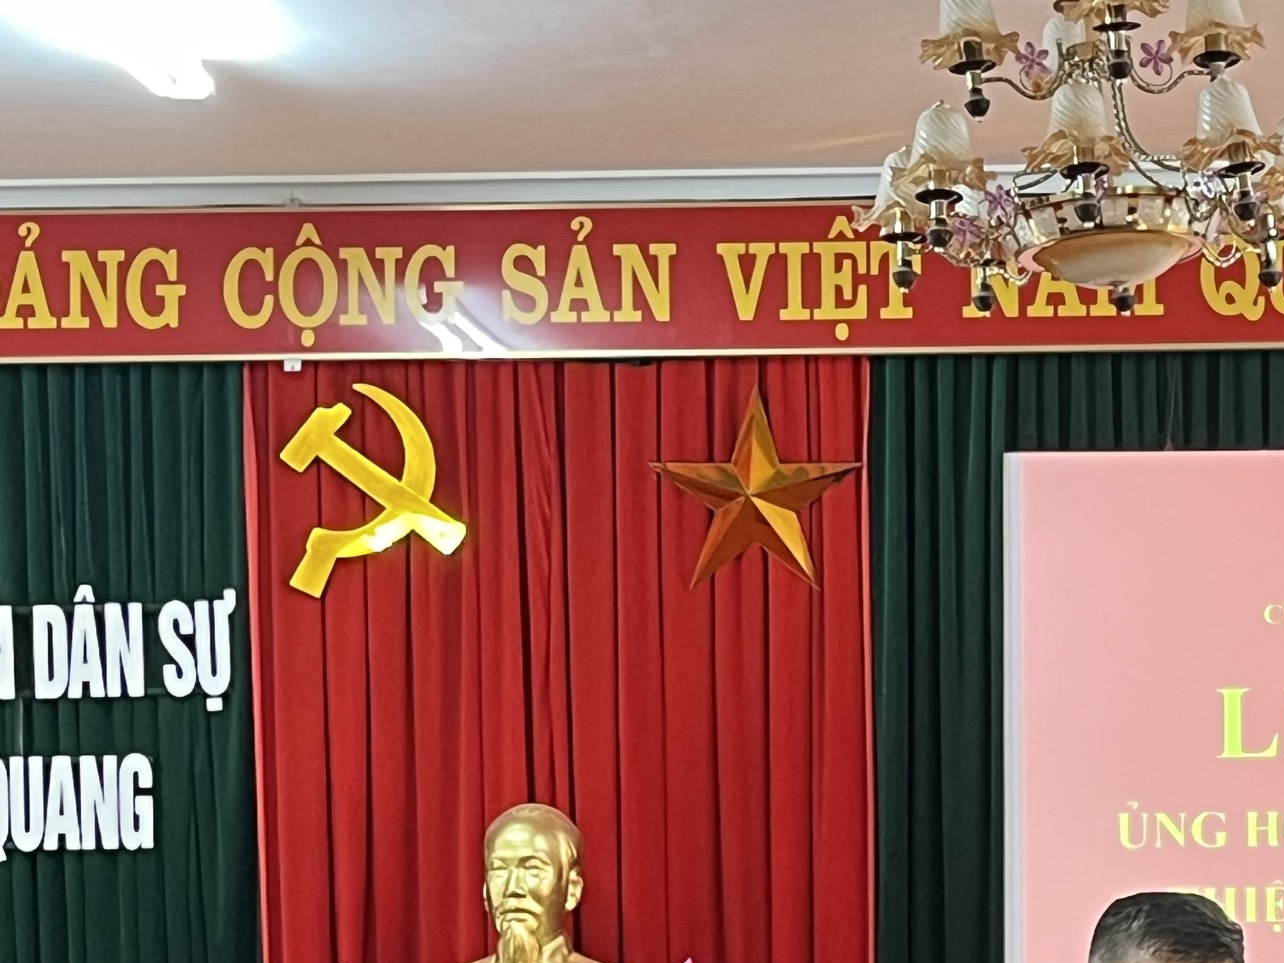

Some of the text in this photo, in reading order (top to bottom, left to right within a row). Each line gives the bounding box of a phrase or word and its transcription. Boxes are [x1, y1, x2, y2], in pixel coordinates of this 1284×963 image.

[0, 222, 187, 330] ẢNG
[223, 222, 466, 348] CỘNG
[501, 215, 677, 325] SẢN
[716, 215, 922, 341] VIỆT
[32, 584, 146, 699] DÂN
[157, 588, 236, 712] SỰ
[0, 752, 154, 862] UANG
[1117, 801, 1228, 850] ỦNG
